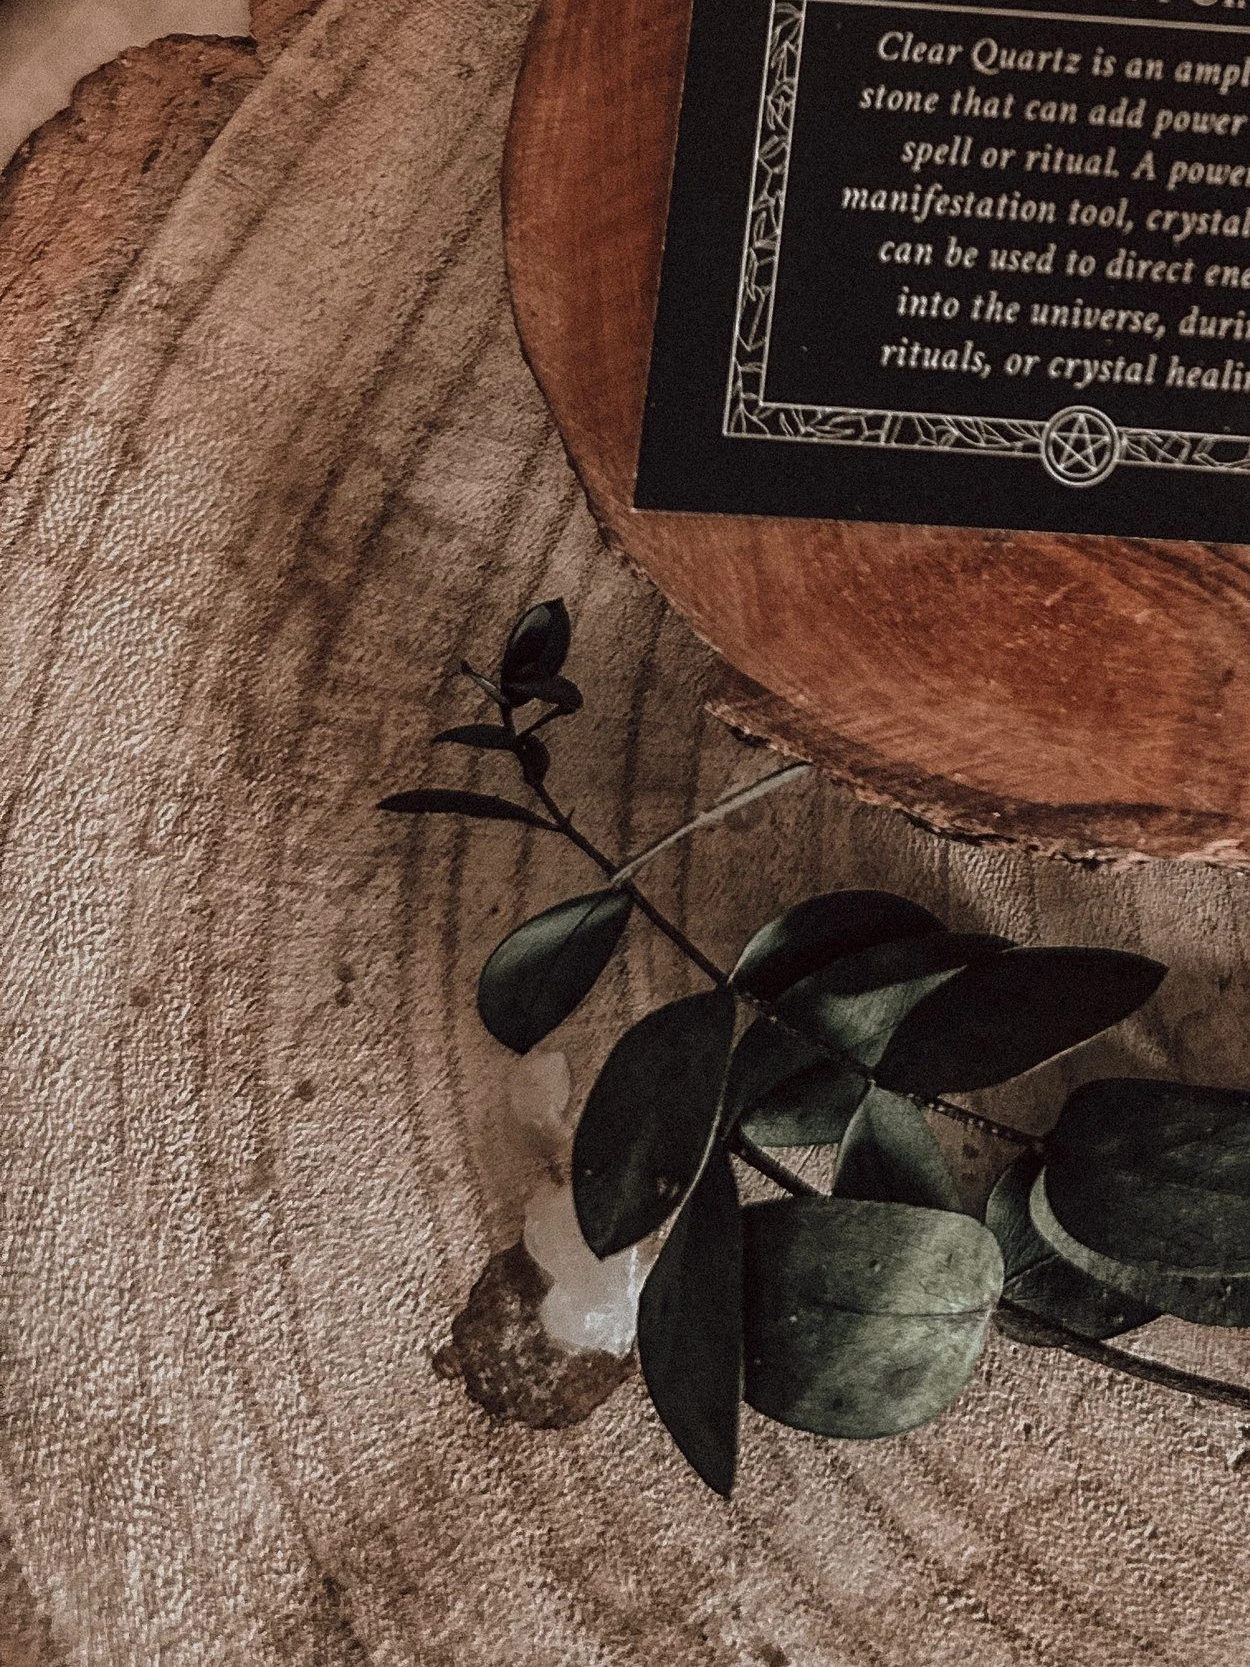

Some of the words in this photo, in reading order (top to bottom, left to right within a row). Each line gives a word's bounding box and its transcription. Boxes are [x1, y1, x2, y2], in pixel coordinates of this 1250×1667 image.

[876, 30, 963, 64] Clear
[970, 37, 1081, 75] Quartz
[1091, 46, 1116, 77] is
[1124, 57, 1163, 80] an
[858, 83, 939, 113] stone
[949, 85, 1014, 119] that
[1024, 99, 1077, 124] can
[1087, 96, 1146, 128] add
[1151, 108, 1248, 139] power
[900, 134, 972, 172] spell
[980, 147, 1016, 169] or
[1024, 143, 1119, 177] ritual.
[1131, 150, 1155, 180] A
[840, 182, 1056, 223] manifestation
[1067, 196, 1133, 233] tool,
[877, 240, 933, 265] can
[944, 235, 979, 268] be
[989, 242, 1057, 273] used
[1065, 249, 1096, 277] to
[1105, 247, 1195, 284] direct
[896, 284, 960, 319] into
[970, 289, 1020, 323] the
[1029, 297, 1166, 339] universe,
[879, 336, 991, 379] rituals,
[1004, 352, 1040, 376] or
[1047, 353, 1158, 389] crystal
